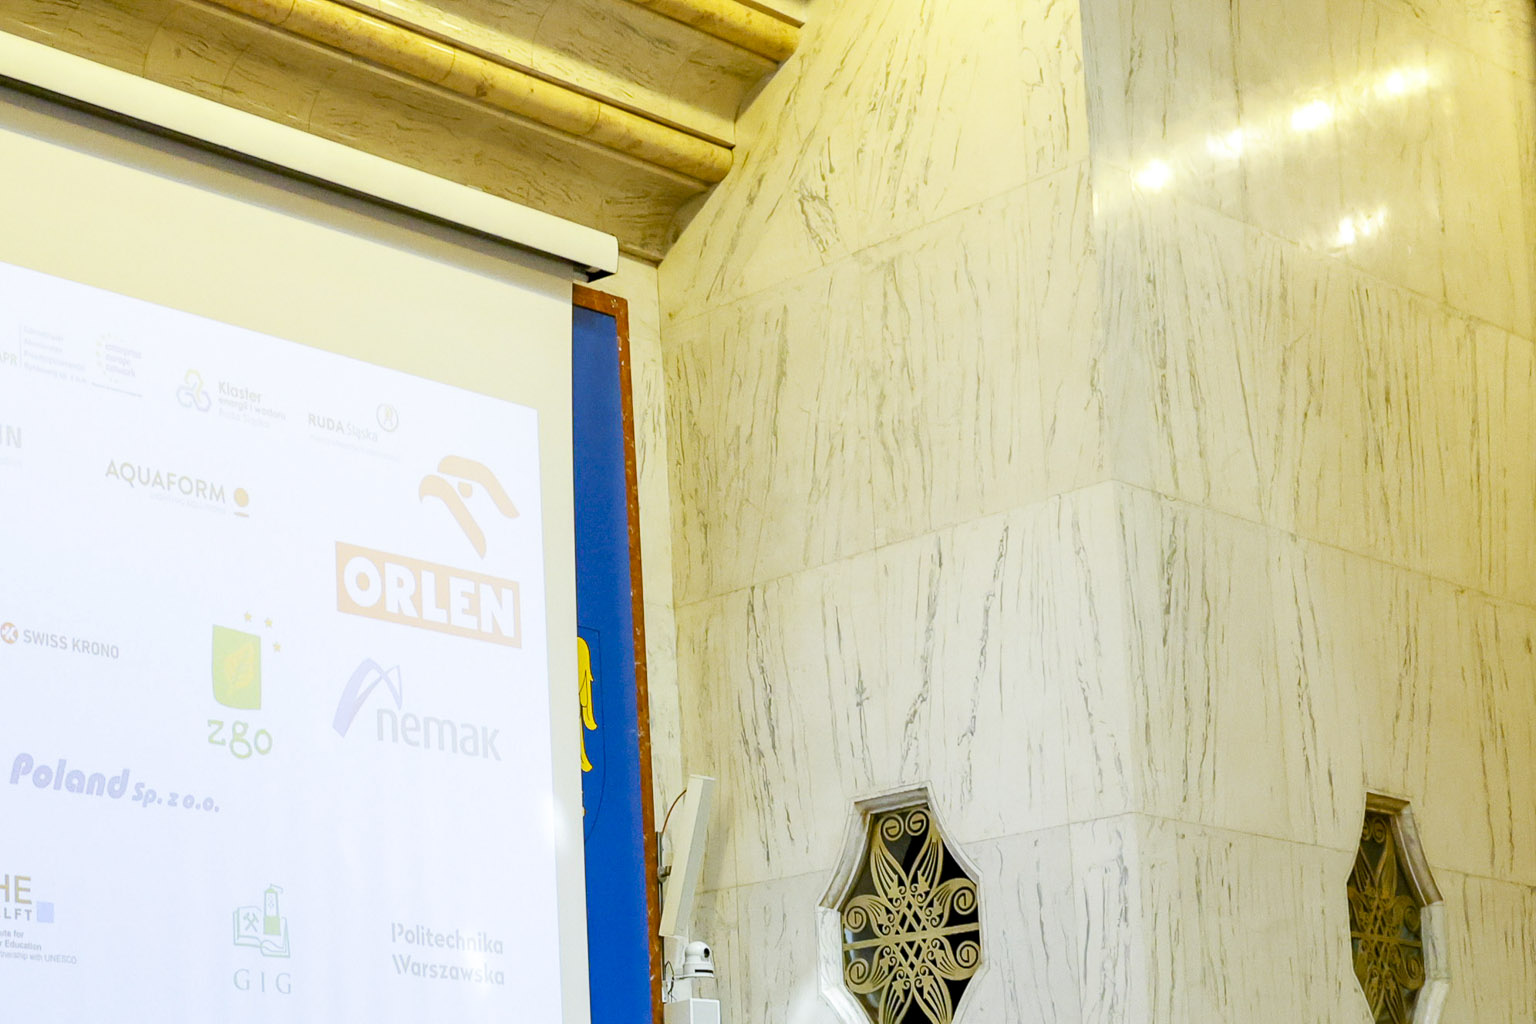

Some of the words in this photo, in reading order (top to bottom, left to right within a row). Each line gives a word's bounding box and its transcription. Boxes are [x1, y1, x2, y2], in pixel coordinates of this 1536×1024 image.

[218, 381, 264, 403] Klaster
[308, 412, 346, 435] RUDA
[104, 458, 226, 505] AQUAFORM
[343, 555, 517, 638] ORLEN
[23, 628, 68, 651] SWISS
[71, 637, 120, 660] KRONO
[207, 718, 273, 760] zgo
[376, 706, 502, 762] nemak
[9, 751, 131, 801] Poland
[391, 922, 505, 955] Politechnika
[391, 953, 505, 986] Warszawska
